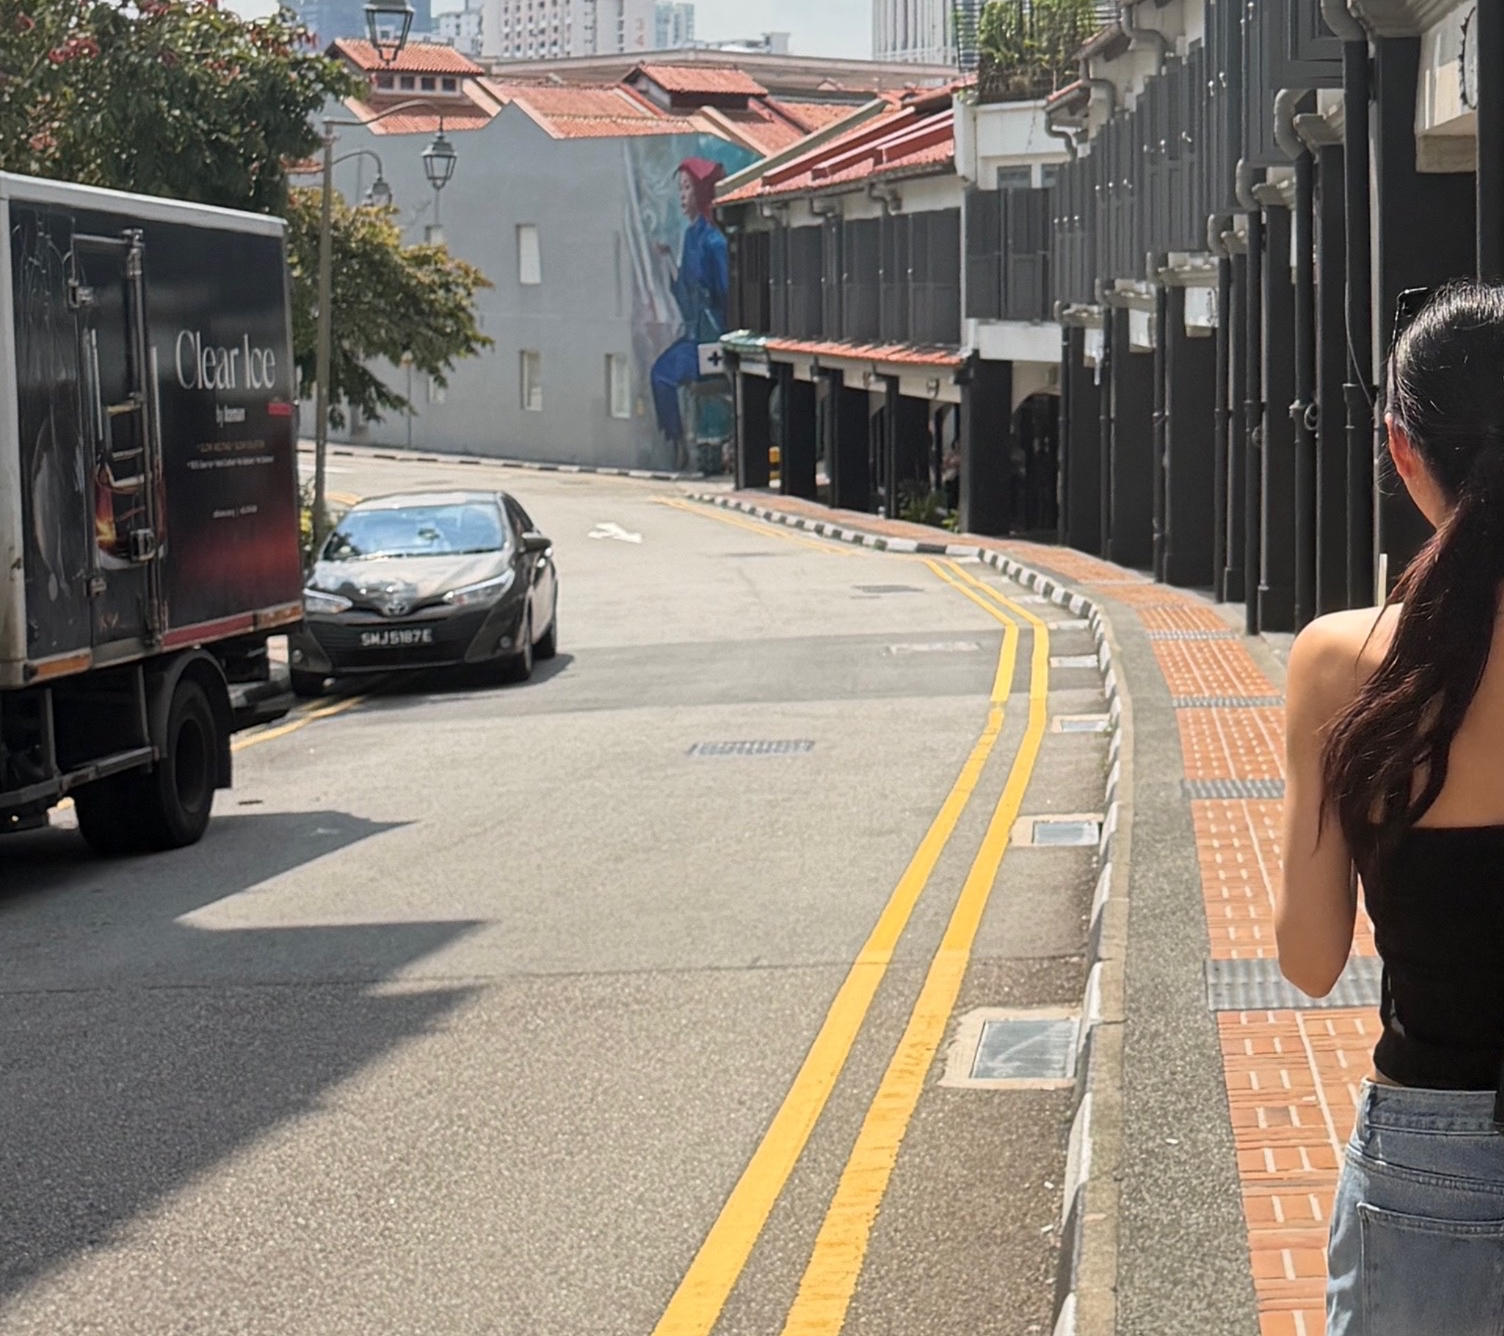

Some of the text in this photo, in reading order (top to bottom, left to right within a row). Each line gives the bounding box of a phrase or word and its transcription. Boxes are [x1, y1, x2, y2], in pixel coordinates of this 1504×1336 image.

[175, 329, 276, 390] Clear Ice
[361, 628, 433, 646] SMJ5187E
